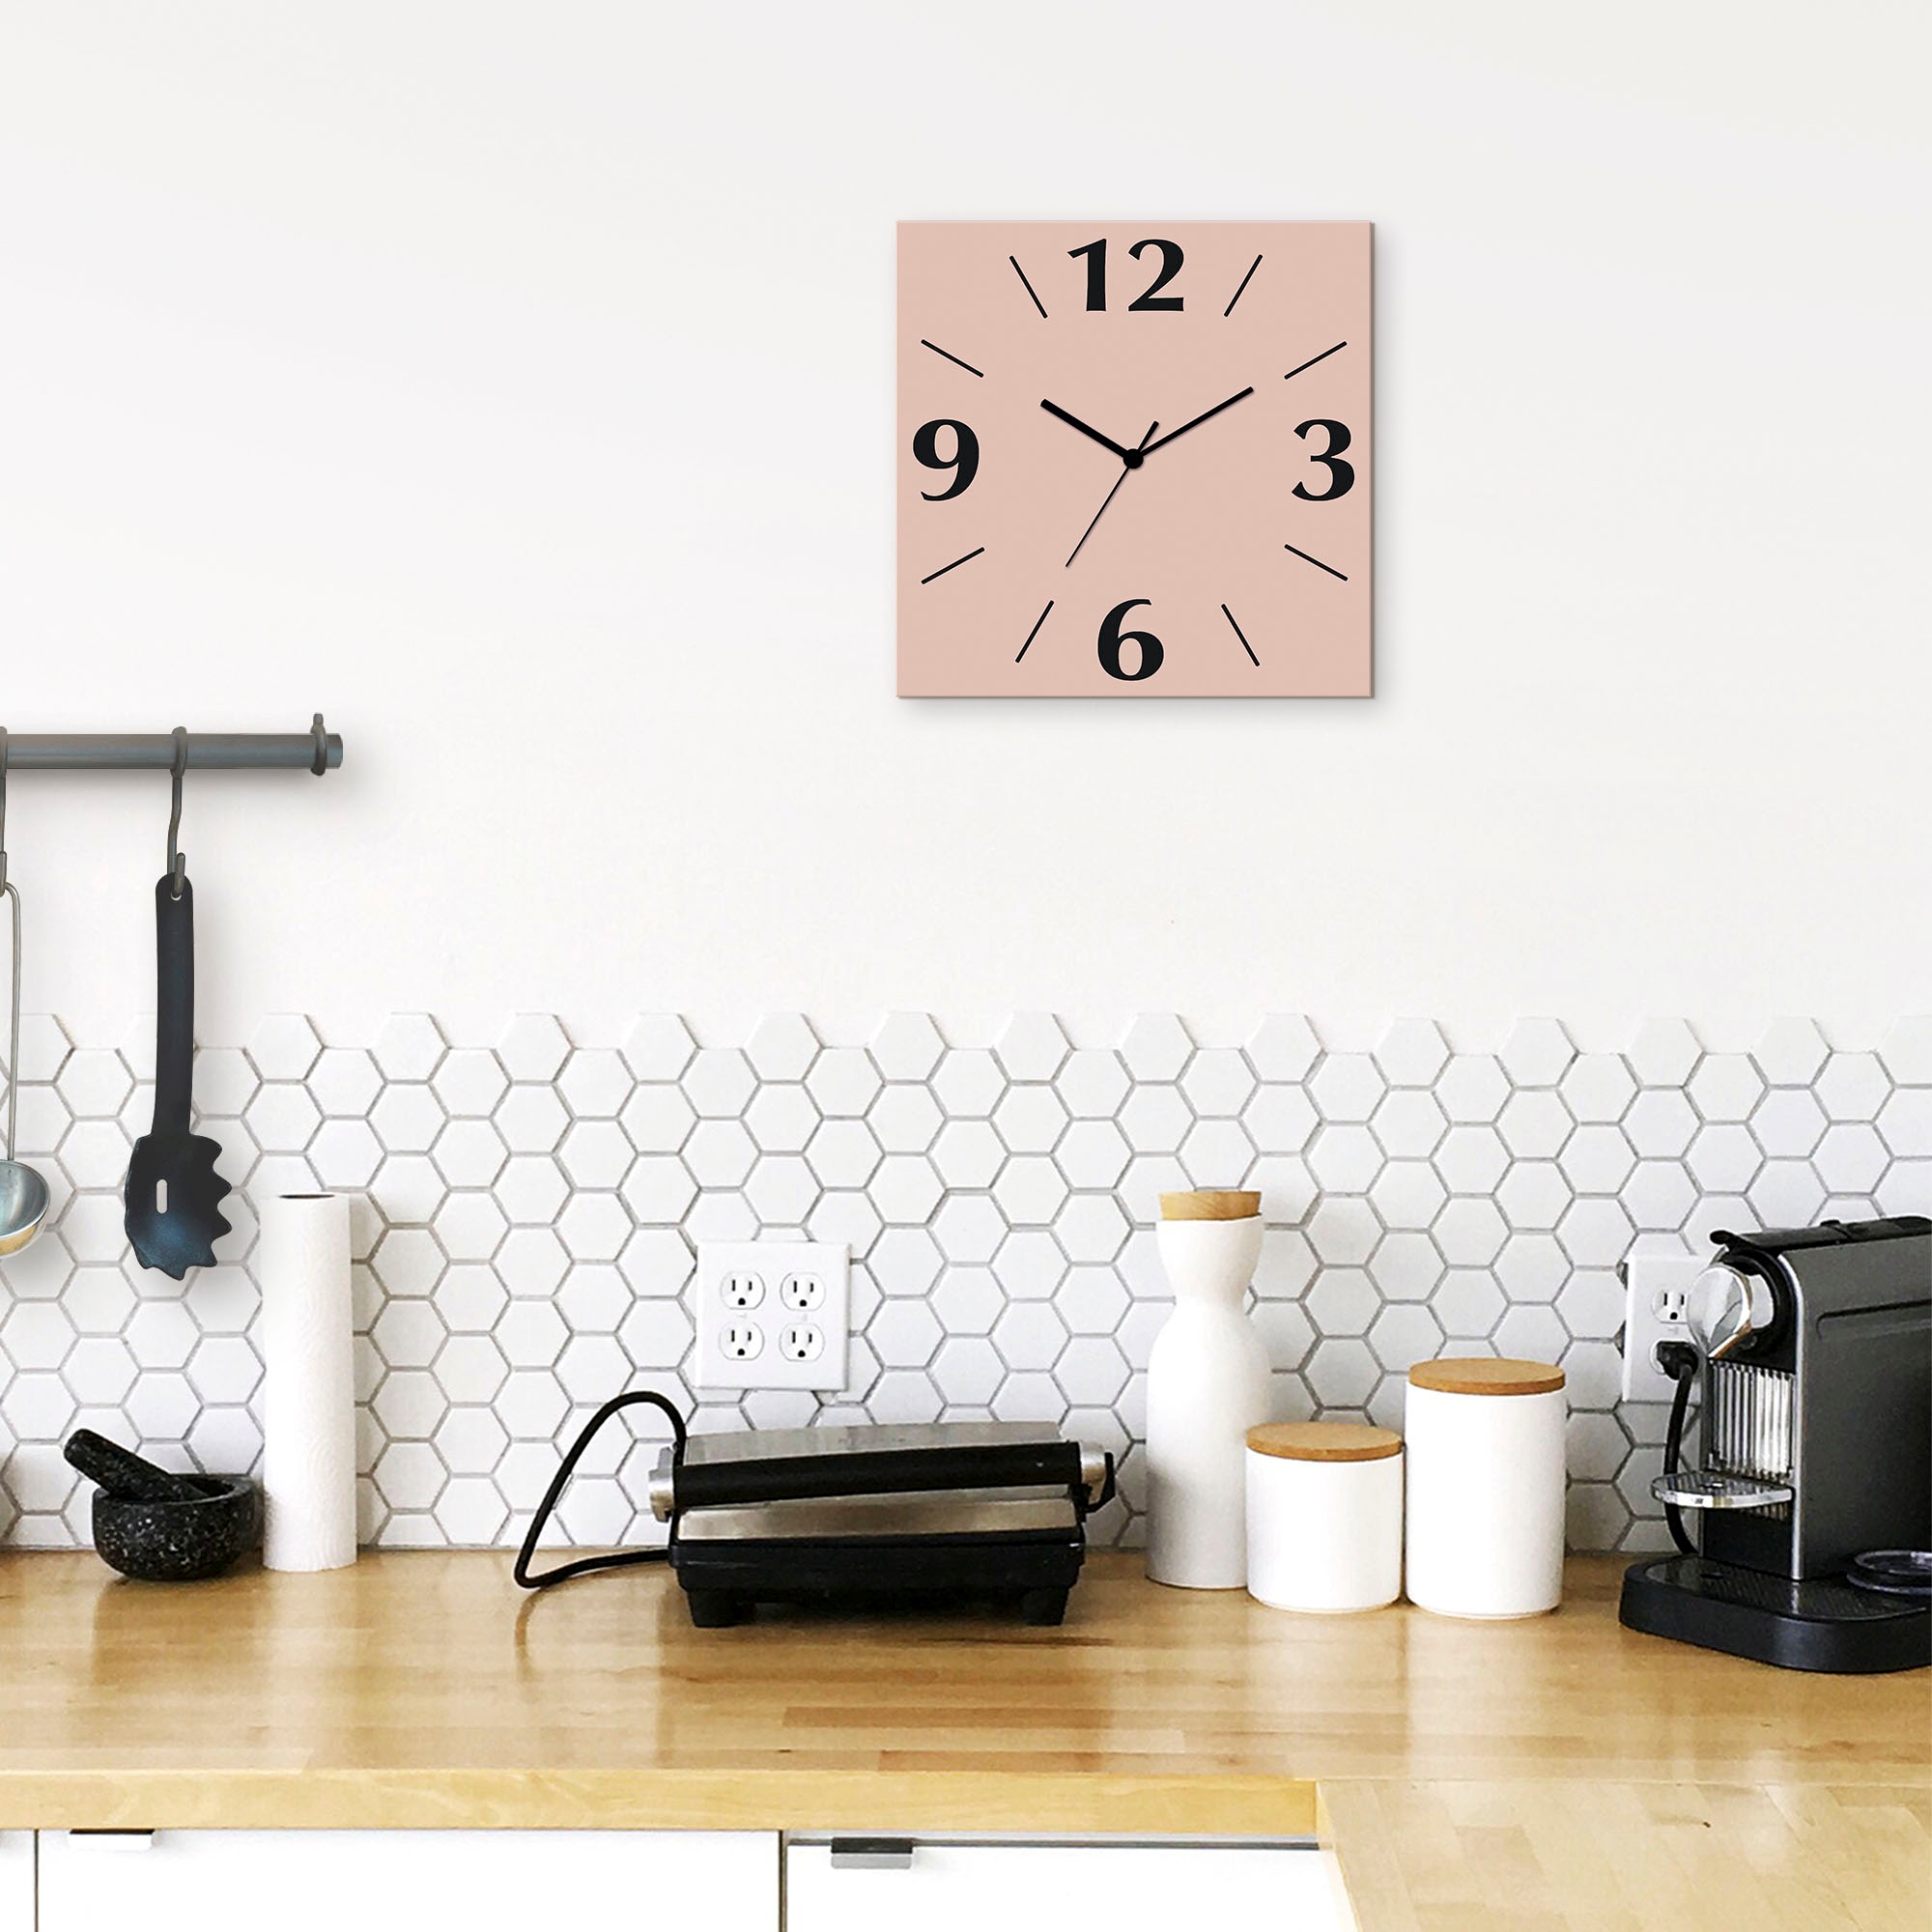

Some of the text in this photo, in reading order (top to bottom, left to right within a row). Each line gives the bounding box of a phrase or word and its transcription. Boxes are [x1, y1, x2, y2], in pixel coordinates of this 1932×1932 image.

[1067, 239, 1184, 312] 12
[913, 419, 980, 502] 9
[1292, 419, 1355, 502] 3
[1098, 599, 1164, 682] 6
